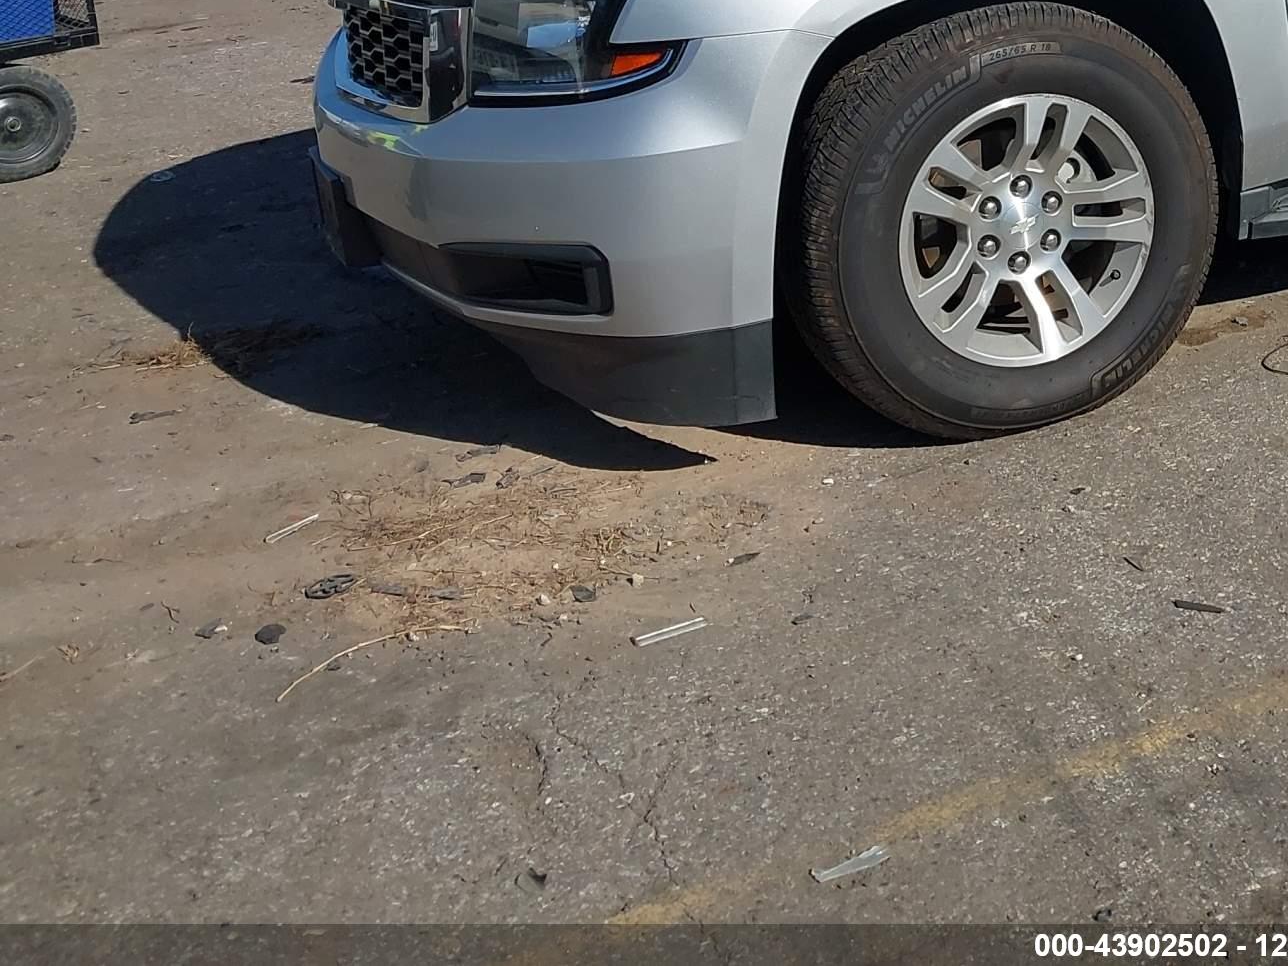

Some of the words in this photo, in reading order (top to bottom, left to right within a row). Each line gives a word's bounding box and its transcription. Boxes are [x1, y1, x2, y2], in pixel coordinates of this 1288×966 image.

[989, 46, 1026, 61] 265/65
[1030, 44, 1036, 53] R
[1041, 43, 1052, 52] 18
[884, 65, 968, 152] MICHELIN
